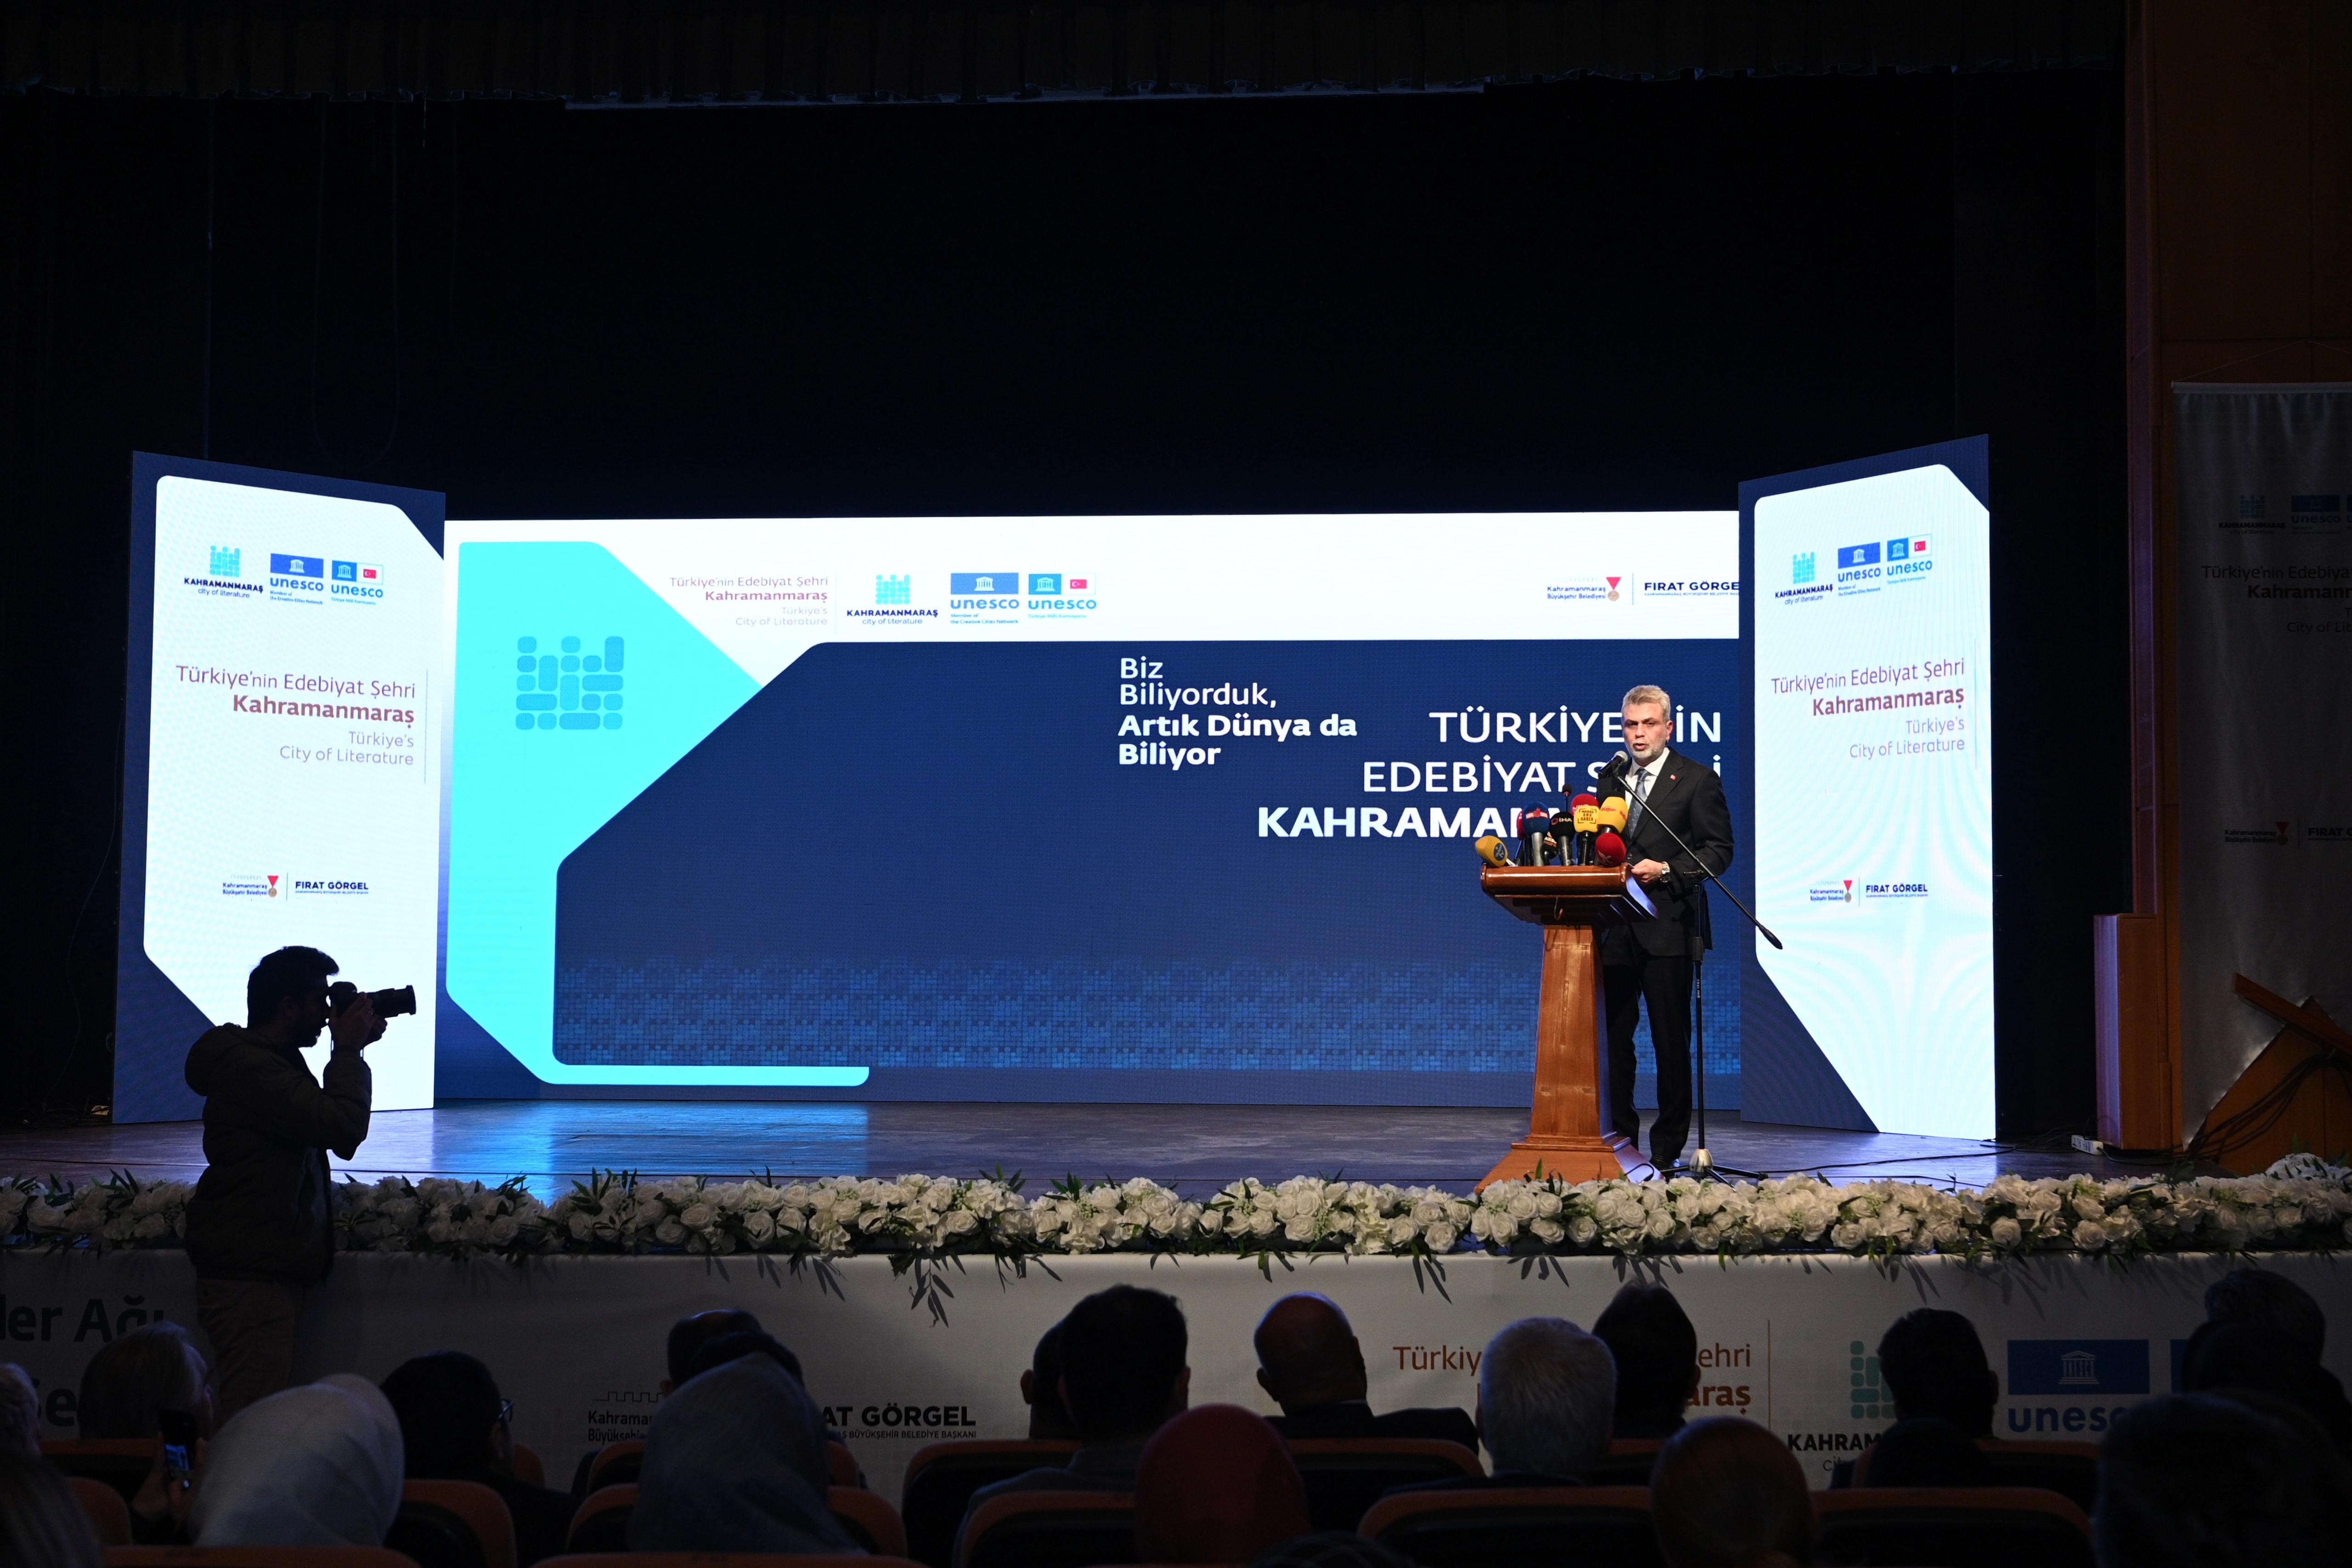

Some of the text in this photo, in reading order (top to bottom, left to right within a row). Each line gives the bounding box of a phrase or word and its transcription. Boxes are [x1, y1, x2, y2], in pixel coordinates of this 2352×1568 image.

[2291, 515, 2341, 523] unesco
[1838, 567, 1881, 583] unesco
[1887, 560, 1933, 577] unesco
[2201, 566, 2352, 582] Türkiye'nin Edebiya
[184, 577, 263, 594] KAHRAMANMARAŞ
[270, 577, 324, 592] unesco
[669, 576, 828, 589] Türkiye'nin Edebiyat Şehri
[1644, 580, 1739, 591] FIRAT GÖRGE
[198, 588, 210, 596] city
[220, 589, 250, 599] literature
[331, 584, 384, 598] unesco
[705, 591, 828, 603] Kahramanmaraş
[1775, 583, 1833, 599] KAHRAMANMARAŞ
[781, 606, 827, 615] Türkiye's
[950, 599, 1020, 609] unesco
[1028, 599, 1097, 610] unesco
[847, 609, 939, 618] KAHRAMANMARAŞ
[735, 617, 827, 627] City of Literature
[2287, 622, 2312, 634] City
[2317, 622, 2331, 633] of
[1120, 656, 1163, 679] Biz
[175, 665, 415, 699] Türkiye'nin Edebiyat Şehri
[1771, 657, 1964, 695] Türkiye'nin Edebiyat Şehri
[1120, 682, 1277, 711] Biliyorduk,
[1813, 687, 1964, 716] Kahramanmaraş
[233, 694, 414, 729] Kahramanmaraş
[1118, 713, 1357, 742] Artık Dünya da
[1906, 716, 1965, 735] Türkiye's
[349, 730, 414, 749] Türkiye's
[280, 745, 414, 765] City of Literature
[1119, 741, 1221, 770] Biliyor
[1850, 738, 1965, 760] City of Literature
[1364, 754, 1576, 792] EDEBİYAT
[2308, 827, 2343, 836] FIRAT
[295, 880, 369, 890] FIRAT GÖRGEL
[1866, 883, 1928, 893] FIRAT GÖRGEL
[1393, 1342, 1750, 1376] Türkiy ehri
[861, 1403, 976, 1426] GÖRGEL
[2008, 1406, 2130, 1432] unes
[849, 1429, 899, 1439] BÜYÜKŞEHİR
[901, 1429, 939, 1439] BELEDİYE
[942, 1430, 976, 1439] BAŞKANI
